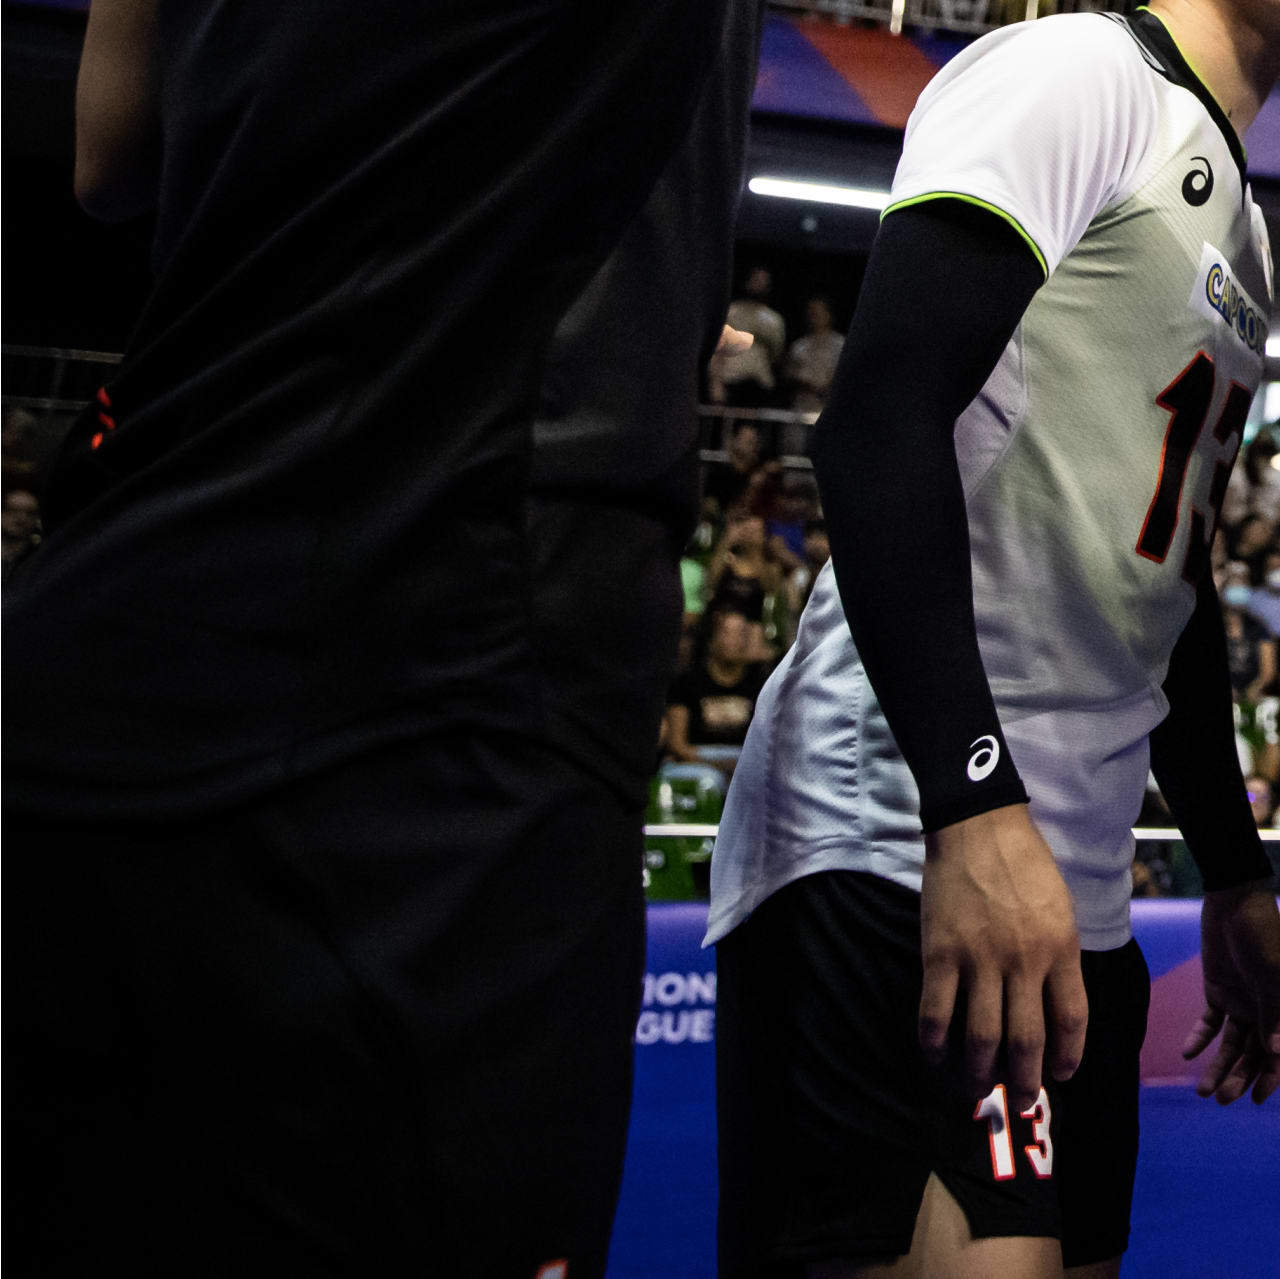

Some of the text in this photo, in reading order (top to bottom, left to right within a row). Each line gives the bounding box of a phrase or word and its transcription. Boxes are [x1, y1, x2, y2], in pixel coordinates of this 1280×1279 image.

[642, 970, 717, 1008] ION
[635, 1008, 714, 1045] GUE
[972, 1082, 1054, 1182] 13
